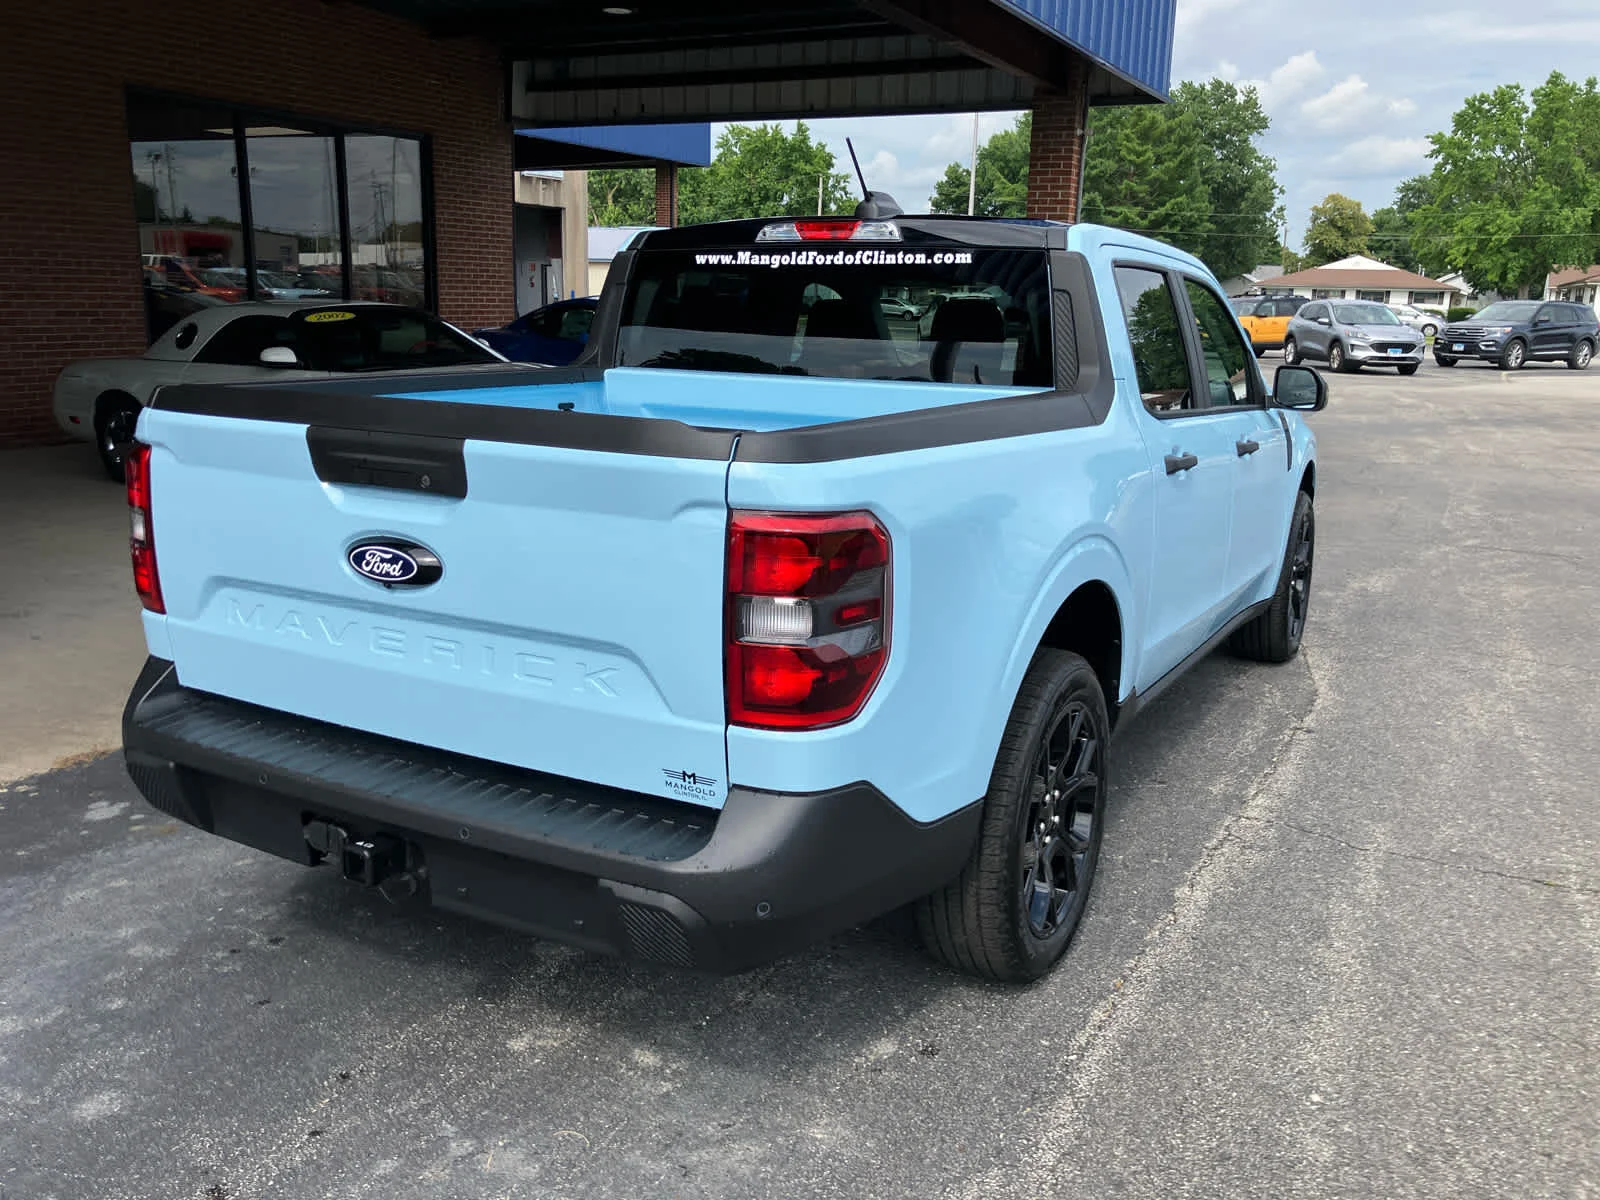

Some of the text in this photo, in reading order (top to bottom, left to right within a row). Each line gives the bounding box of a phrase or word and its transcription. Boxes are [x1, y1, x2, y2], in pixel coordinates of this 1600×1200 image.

[695, 250, 973, 268] www.MangoldFordofClinton.com
[362, 550, 403, 577] Ford
[225, 600, 620, 697] MAVERICK
[665, 780, 716, 797] MANGOLD
